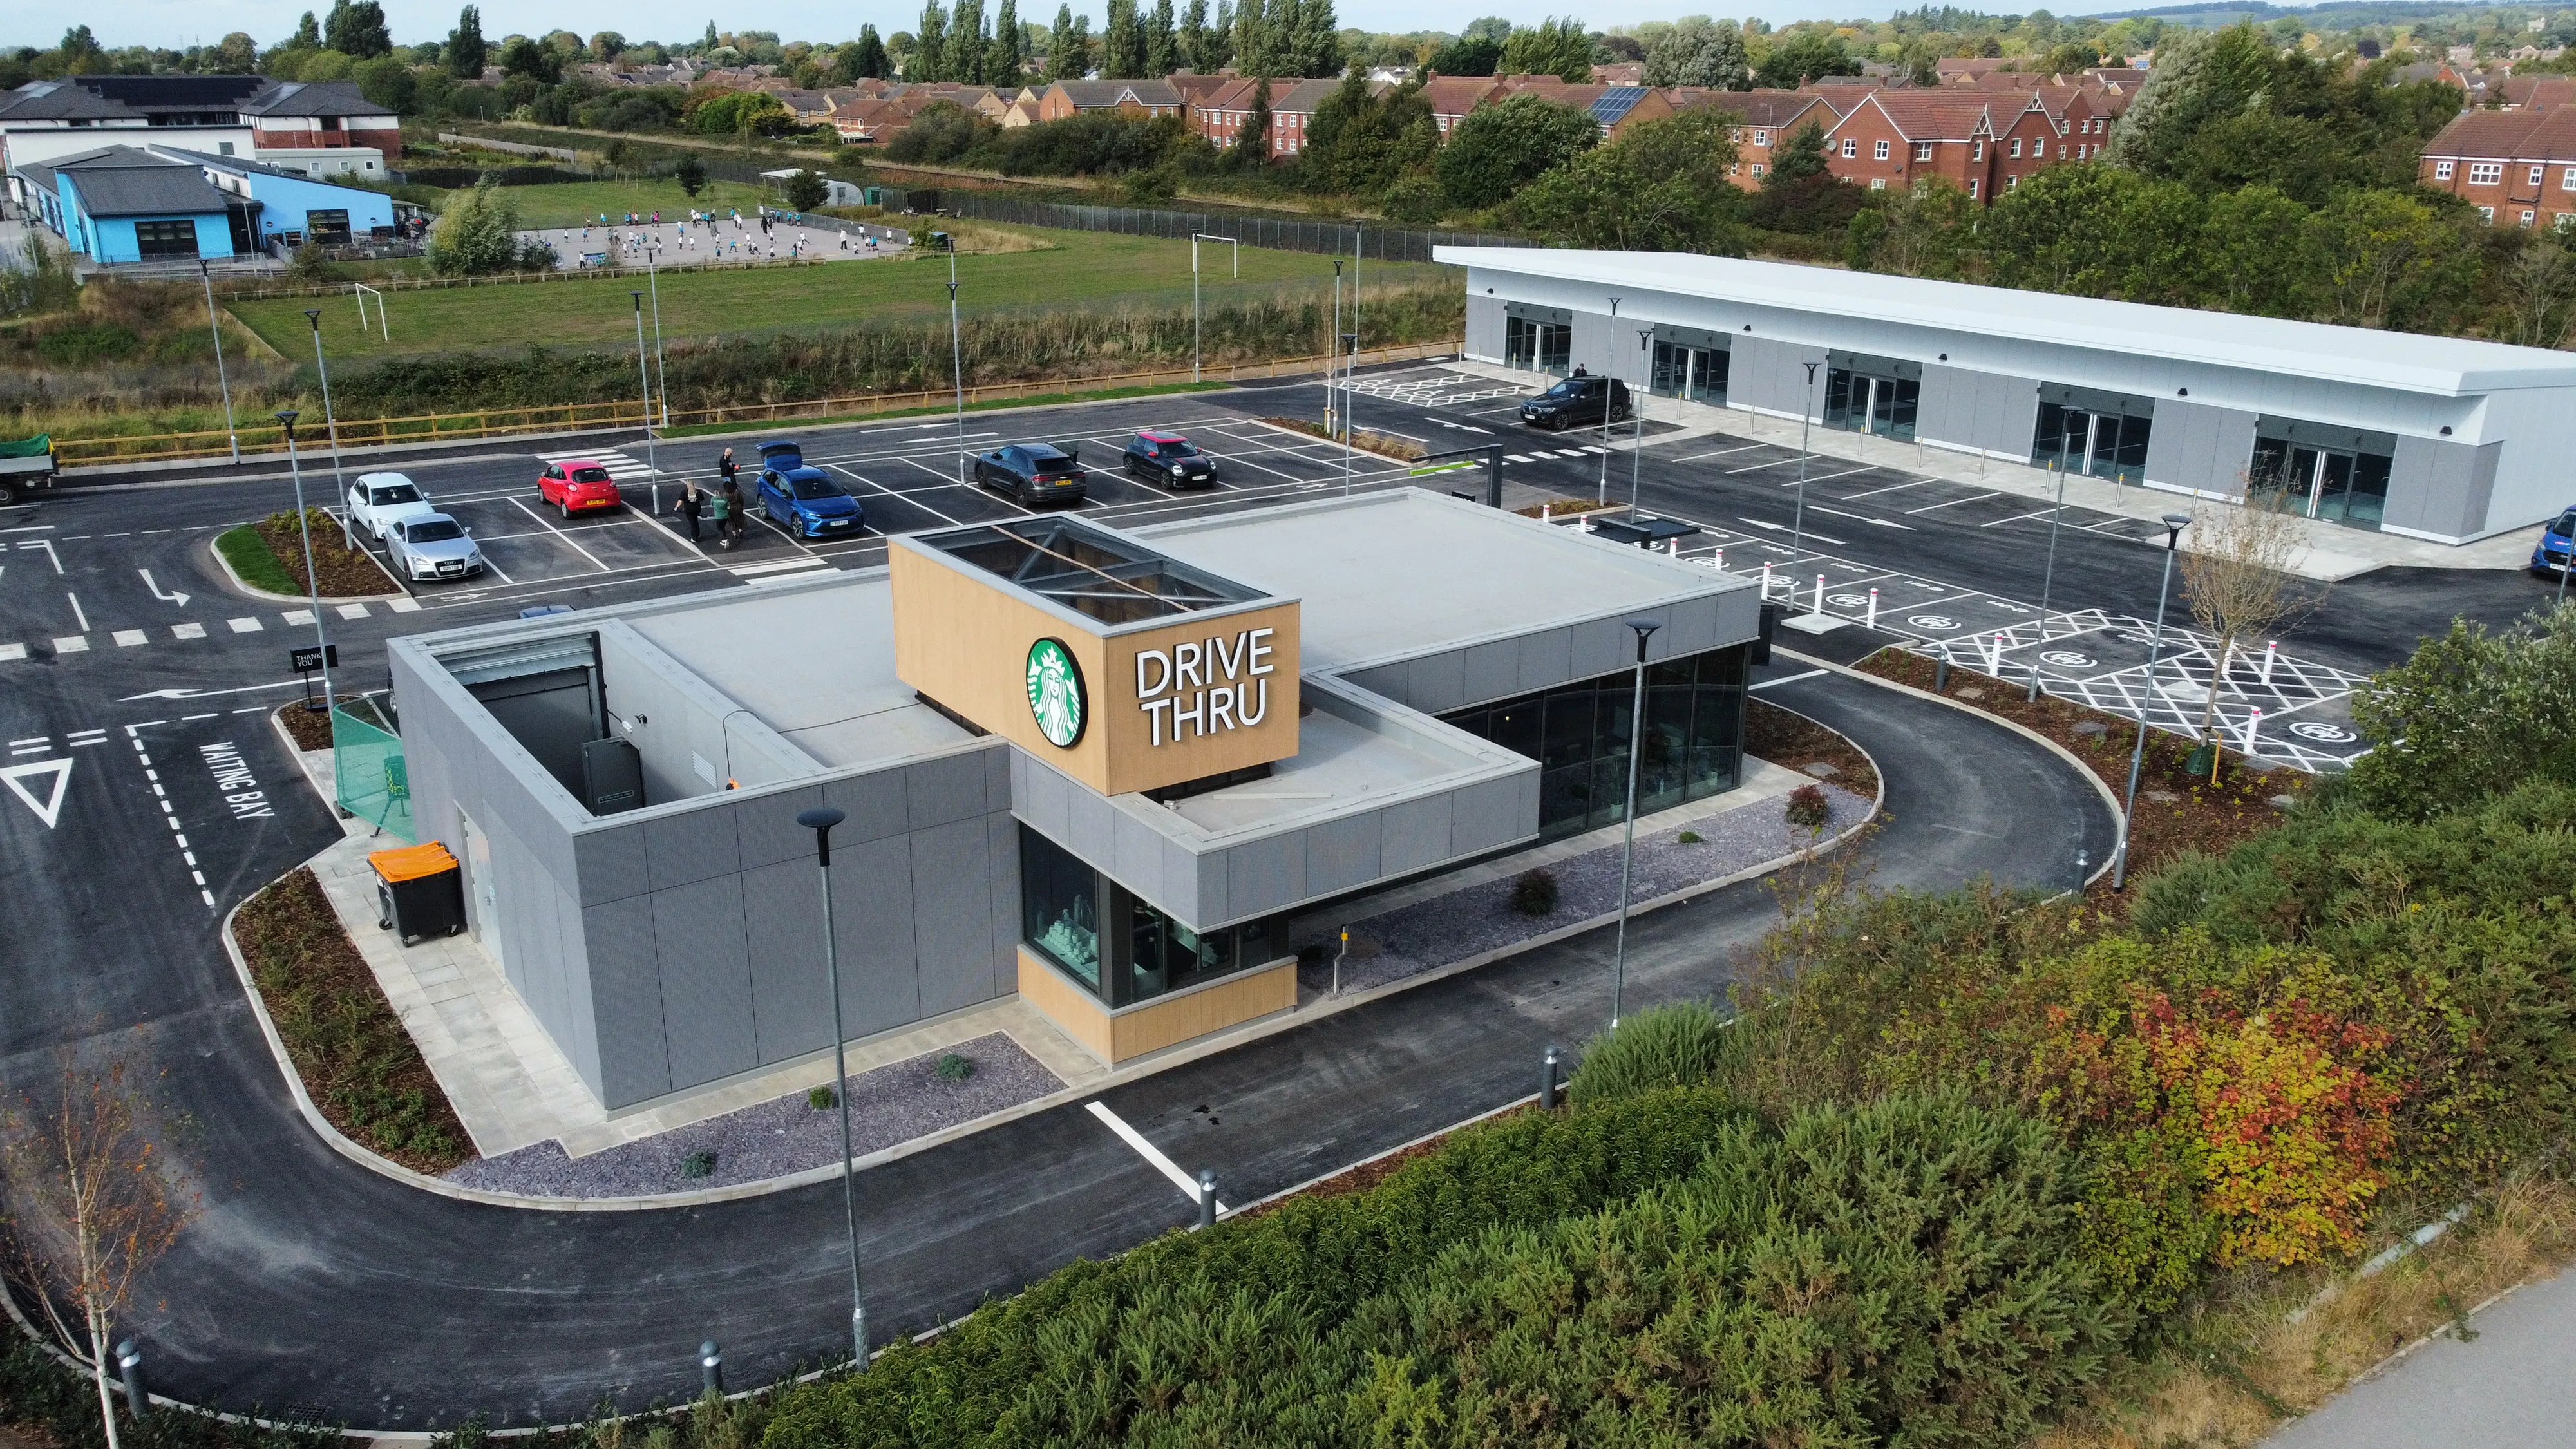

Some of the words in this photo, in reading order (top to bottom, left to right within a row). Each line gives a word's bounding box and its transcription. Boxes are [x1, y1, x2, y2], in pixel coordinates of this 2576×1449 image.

[296, 652, 322, 661] THANK
[1135, 627, 1273, 699] DRIVE
[1139, 678, 1265, 746] THRU
[198, 741, 256, 791] WAITING
[225, 791, 275, 819] BAY
